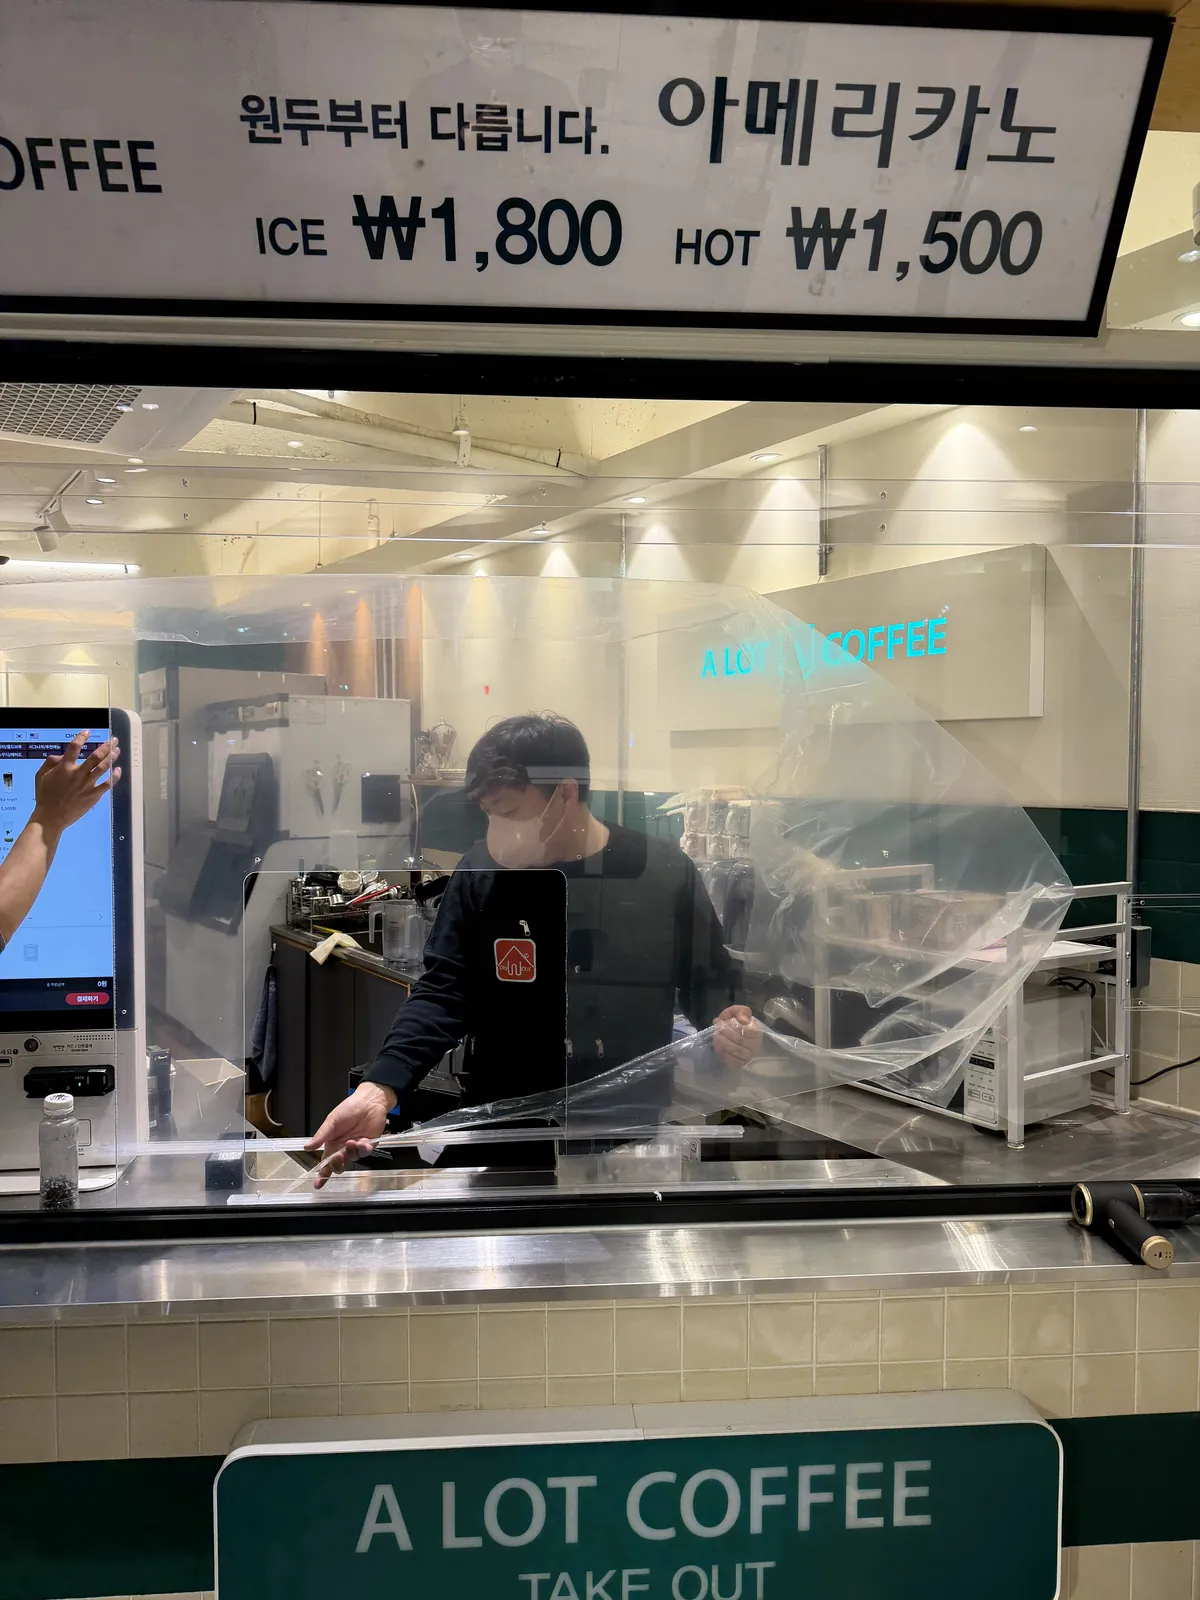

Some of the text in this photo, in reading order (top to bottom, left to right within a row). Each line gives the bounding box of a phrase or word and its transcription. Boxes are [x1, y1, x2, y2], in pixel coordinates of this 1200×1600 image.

[239, 95, 609, 155] 원두부터 다릅니다.
[658, 76, 1057, 171] 아메리카노
[255, 194, 622, 272] ICE ₩1,800
[675, 206, 1043, 282] HOT ₩1,500
[701, 649, 718, 679] A
[822, 617, 947, 668] COFFEE
[354, 1460, 932, 1552] A LOT COFFEE
[518, 1561, 775, 1600] TAKE OUT
